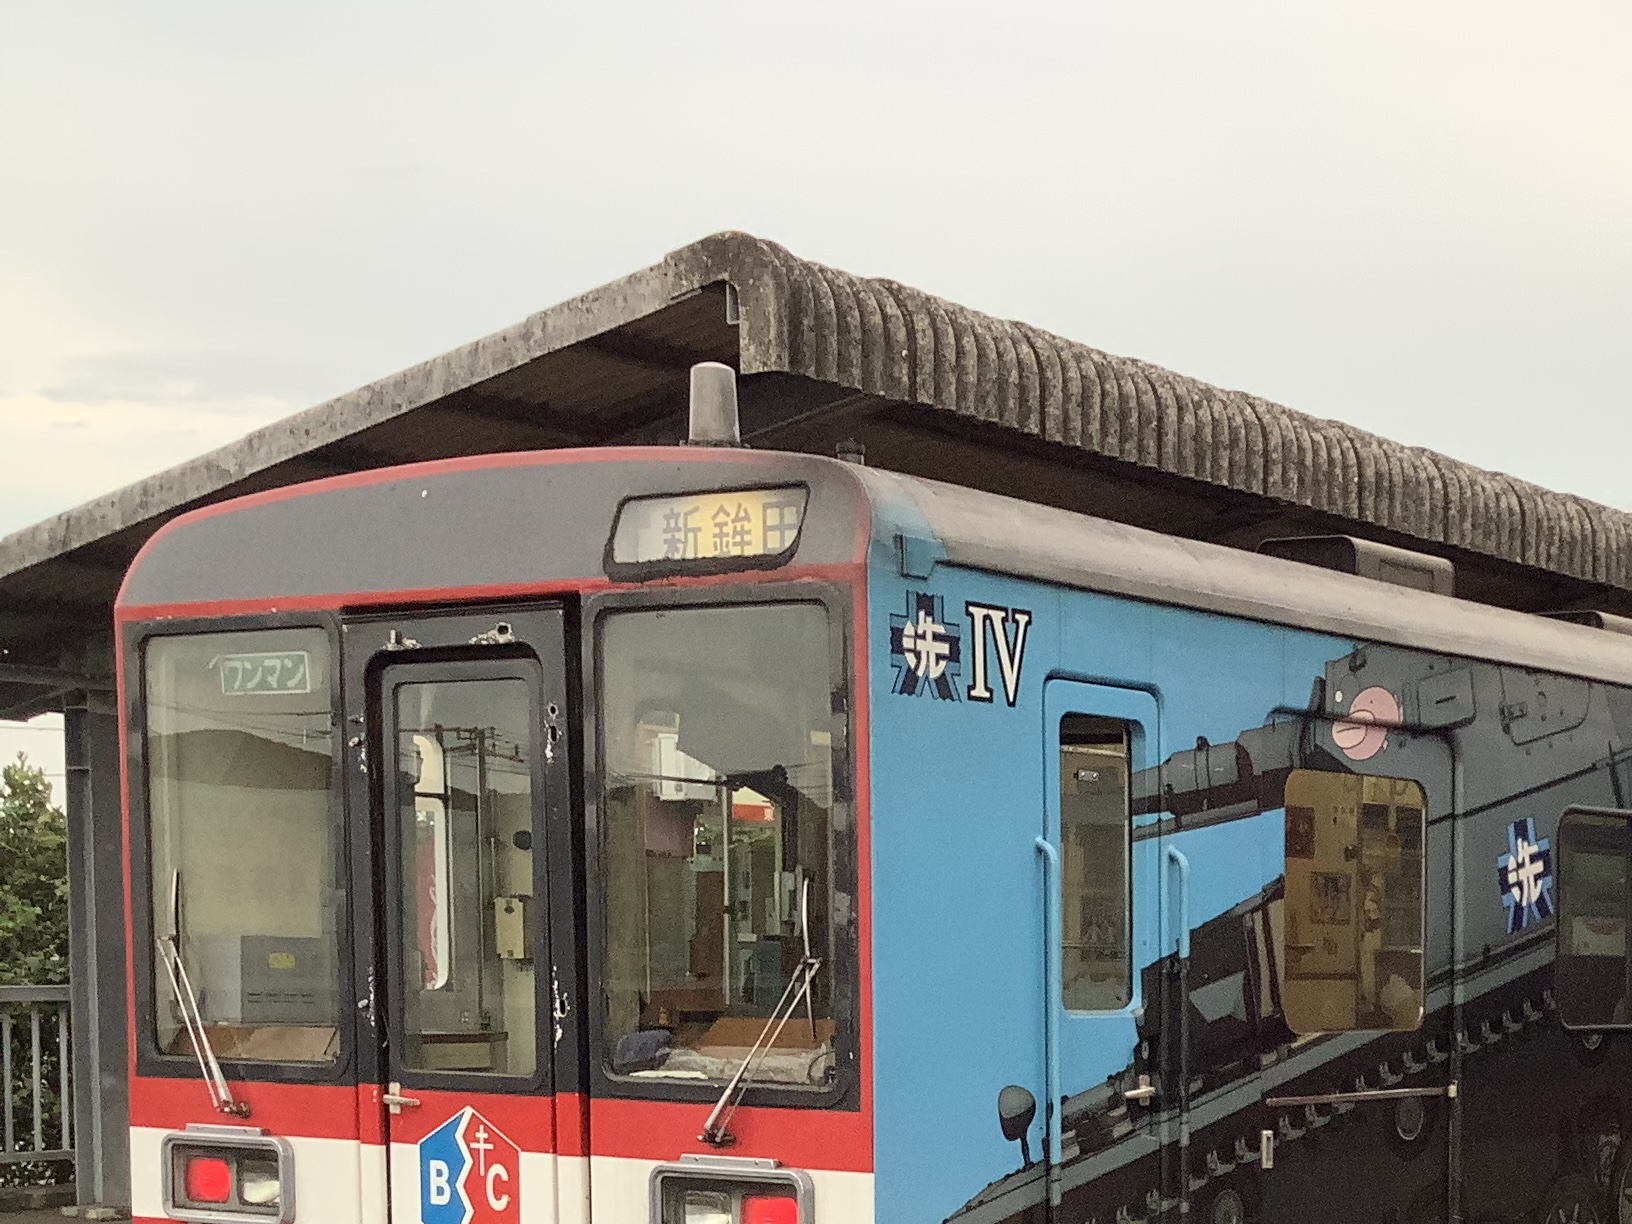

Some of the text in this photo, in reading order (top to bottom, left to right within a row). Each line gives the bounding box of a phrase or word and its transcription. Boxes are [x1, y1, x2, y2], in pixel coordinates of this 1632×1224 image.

[662, 503, 801, 558] 新鉾田
[223, 658, 305, 689] ワンマン
[429, 1159, 509, 1211] B C
